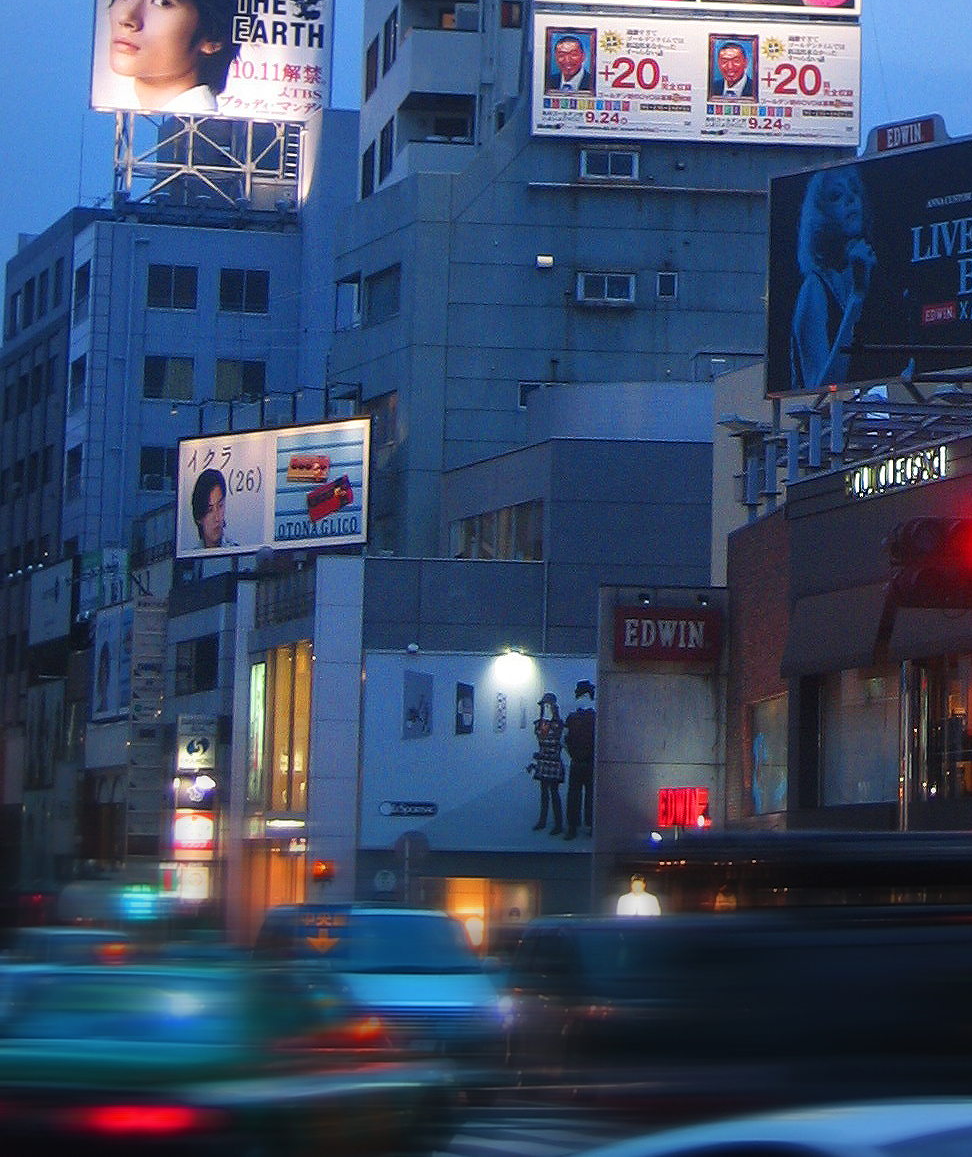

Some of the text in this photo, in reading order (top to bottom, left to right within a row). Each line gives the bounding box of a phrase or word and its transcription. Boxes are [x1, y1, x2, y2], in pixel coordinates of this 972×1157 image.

[231, 16, 325, 50] EARTH
[584, 111, 620, 124] 9.24
[748, 117, 783, 130] 9.24
[886, 122, 922, 149] EDWIN
[187, 445, 263, 495] イクラ (26)
[623, 618, 706, 650] EDWIN
